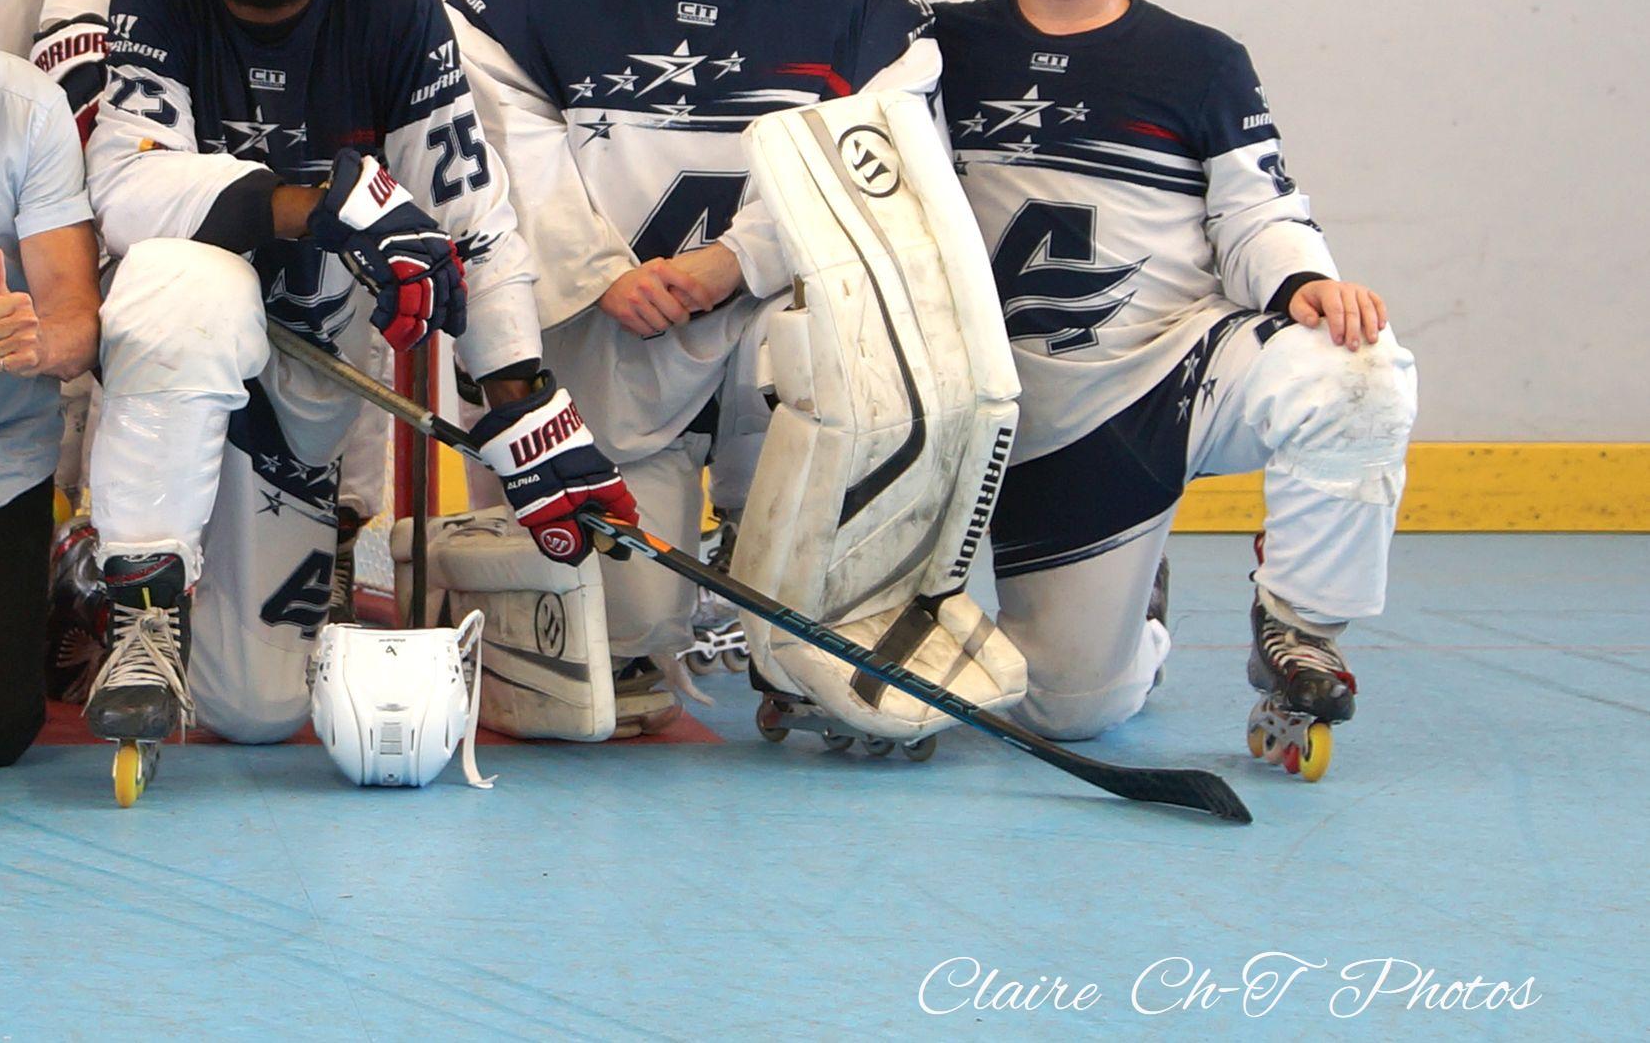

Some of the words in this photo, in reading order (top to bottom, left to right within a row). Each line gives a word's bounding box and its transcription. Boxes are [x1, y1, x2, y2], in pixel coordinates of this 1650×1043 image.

[679, 3, 717, 19] CIT
[251, 69, 286, 84] CIT
[427, 110, 491, 207] 25
[507, 473, 541, 491] ALPHA
[949, 427, 1013, 579] WARRIOR
